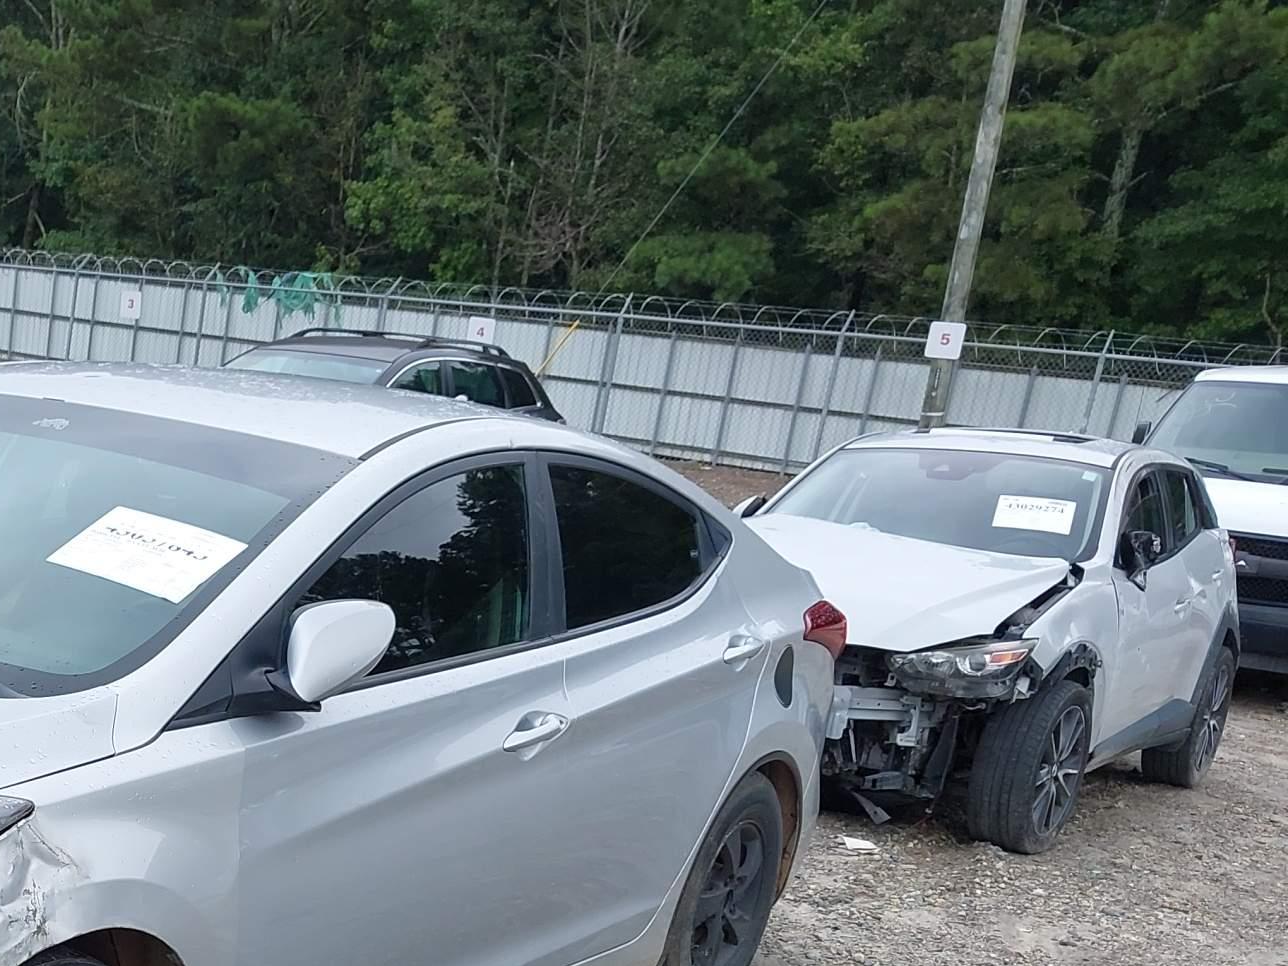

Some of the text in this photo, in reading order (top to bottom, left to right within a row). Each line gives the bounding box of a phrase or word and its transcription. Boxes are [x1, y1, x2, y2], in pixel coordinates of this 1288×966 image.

[127, 299, 135, 309] 3
[476, 327, 485, 337] 4
[940, 333, 951, 346] 5
